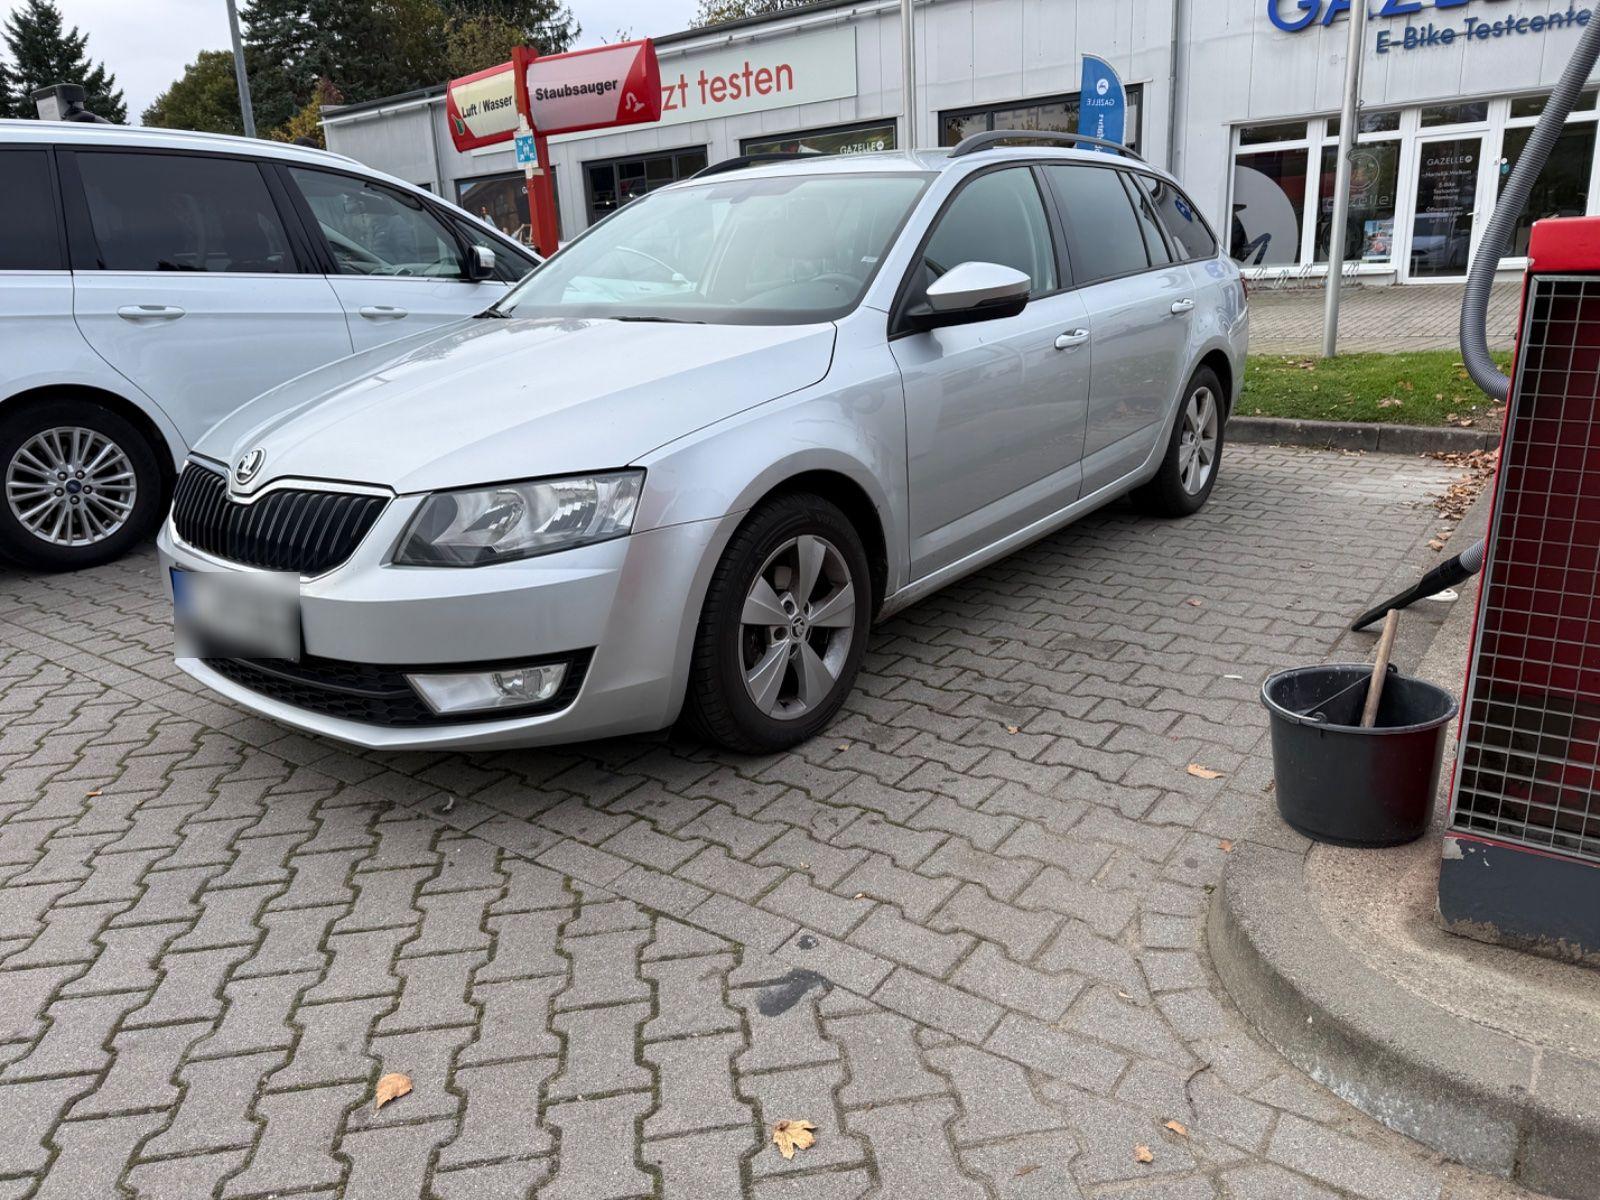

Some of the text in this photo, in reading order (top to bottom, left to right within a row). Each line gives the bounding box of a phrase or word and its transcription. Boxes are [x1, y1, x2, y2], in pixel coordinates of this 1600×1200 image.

[1376, 22, 1456, 54] E-Bike
[534, 77, 619, 101] Staubsauger
[697, 61, 793, 105] testen
[462, 103, 478, 118] Luft
[483, 95, 513, 112] Wasser
[839, 141, 877, 155] GAZELLE
[1427, 156, 1464, 165] GAZELLE
